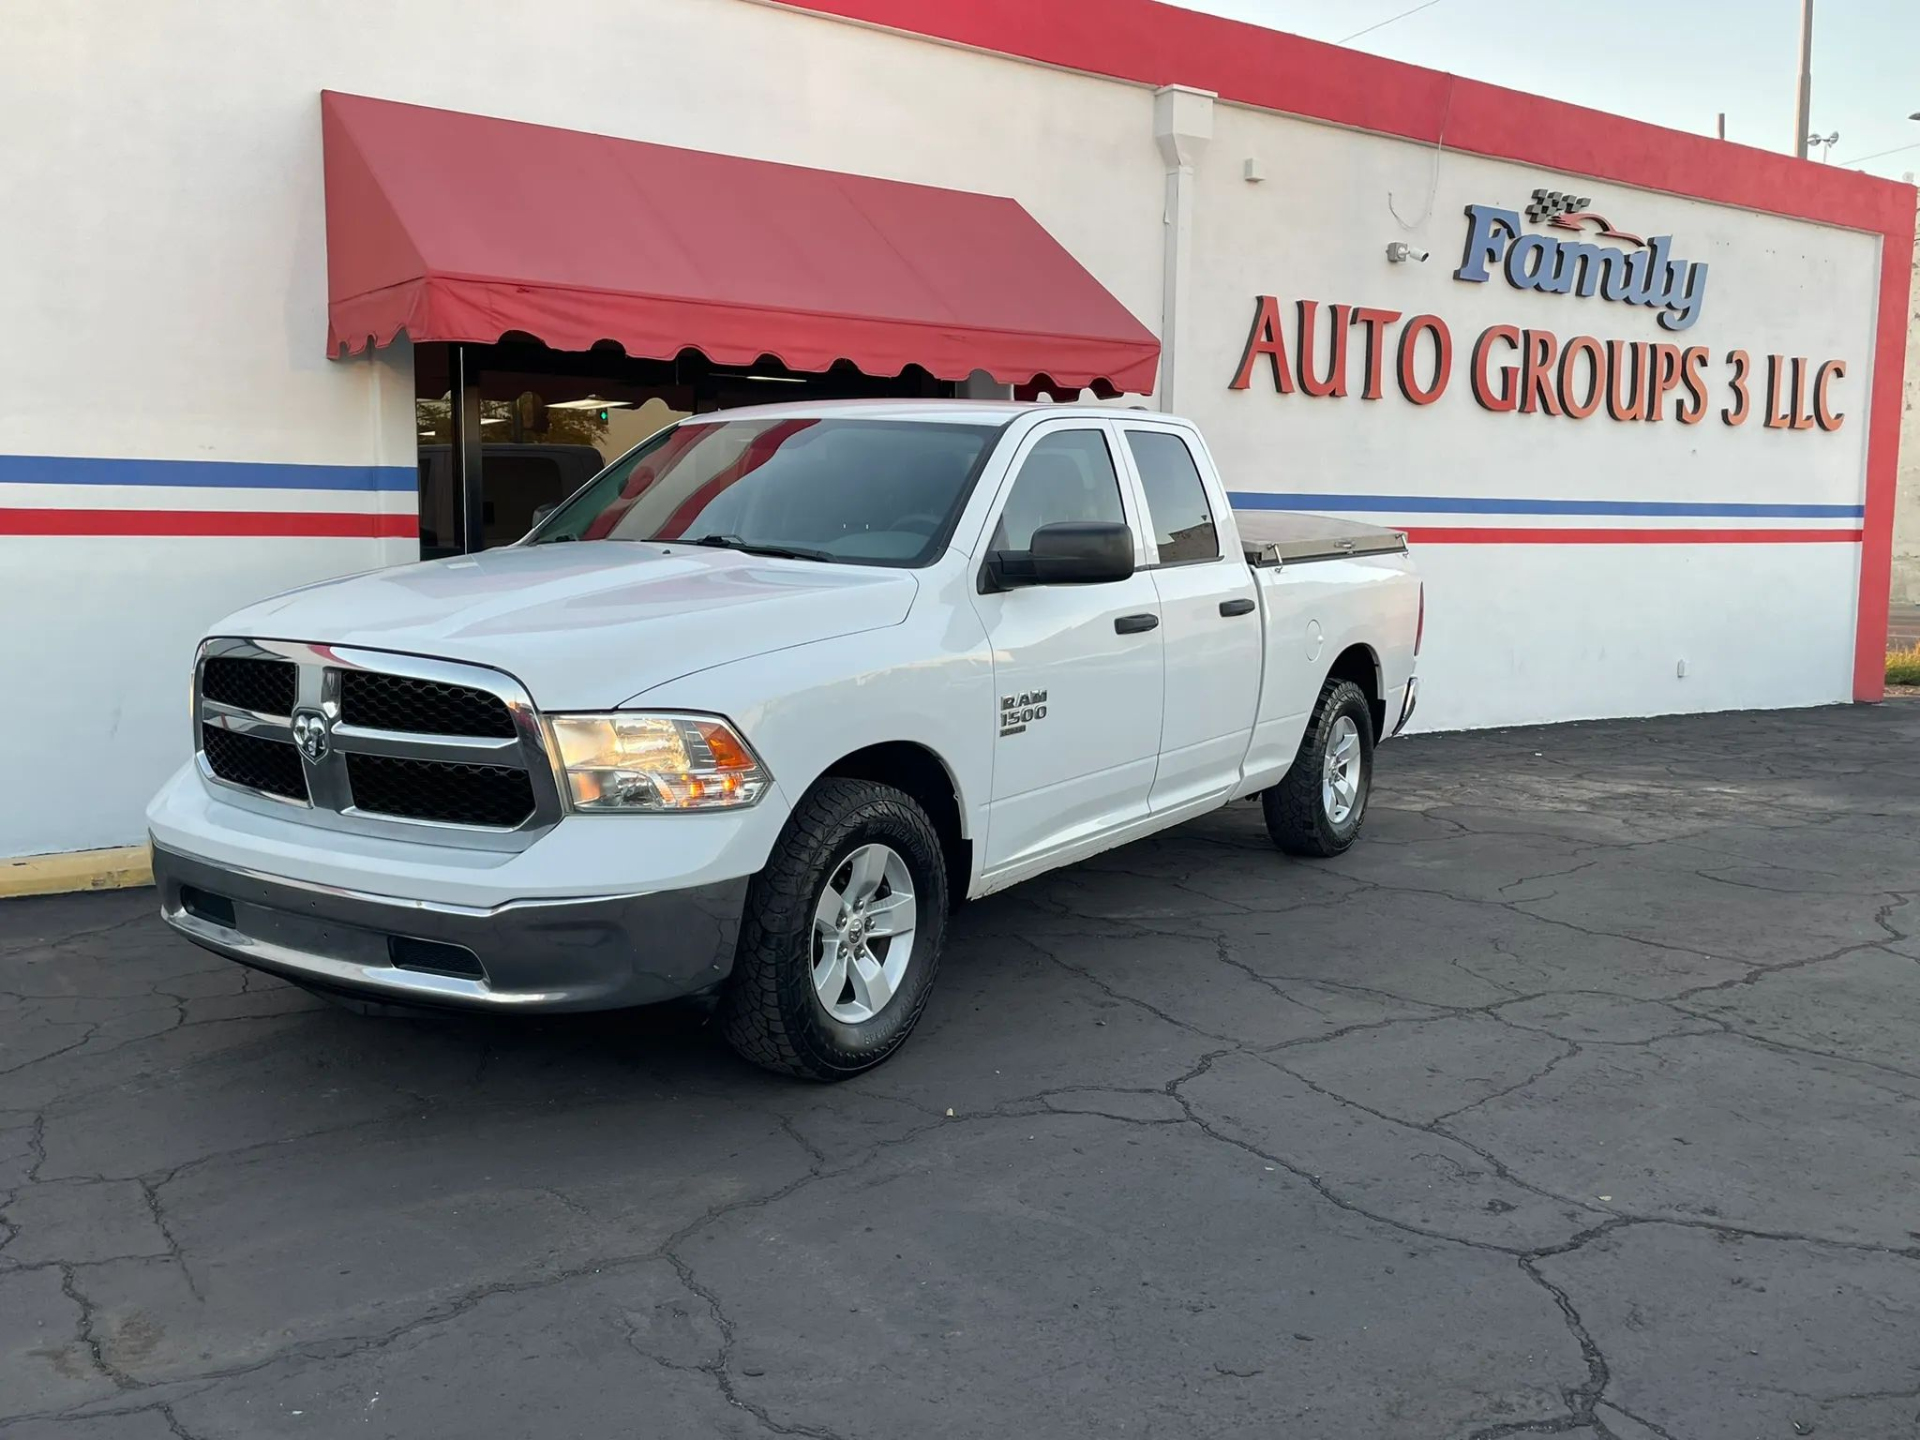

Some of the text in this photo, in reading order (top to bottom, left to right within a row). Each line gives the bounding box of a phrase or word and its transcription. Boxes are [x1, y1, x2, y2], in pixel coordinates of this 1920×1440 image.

[1453, 204, 1709, 331] Family
[1228, 295, 1847, 431] AUTO GROUPS 3 LLC
[1000, 689, 1048, 711] RAM
[1000, 705, 1048, 727] 1500
